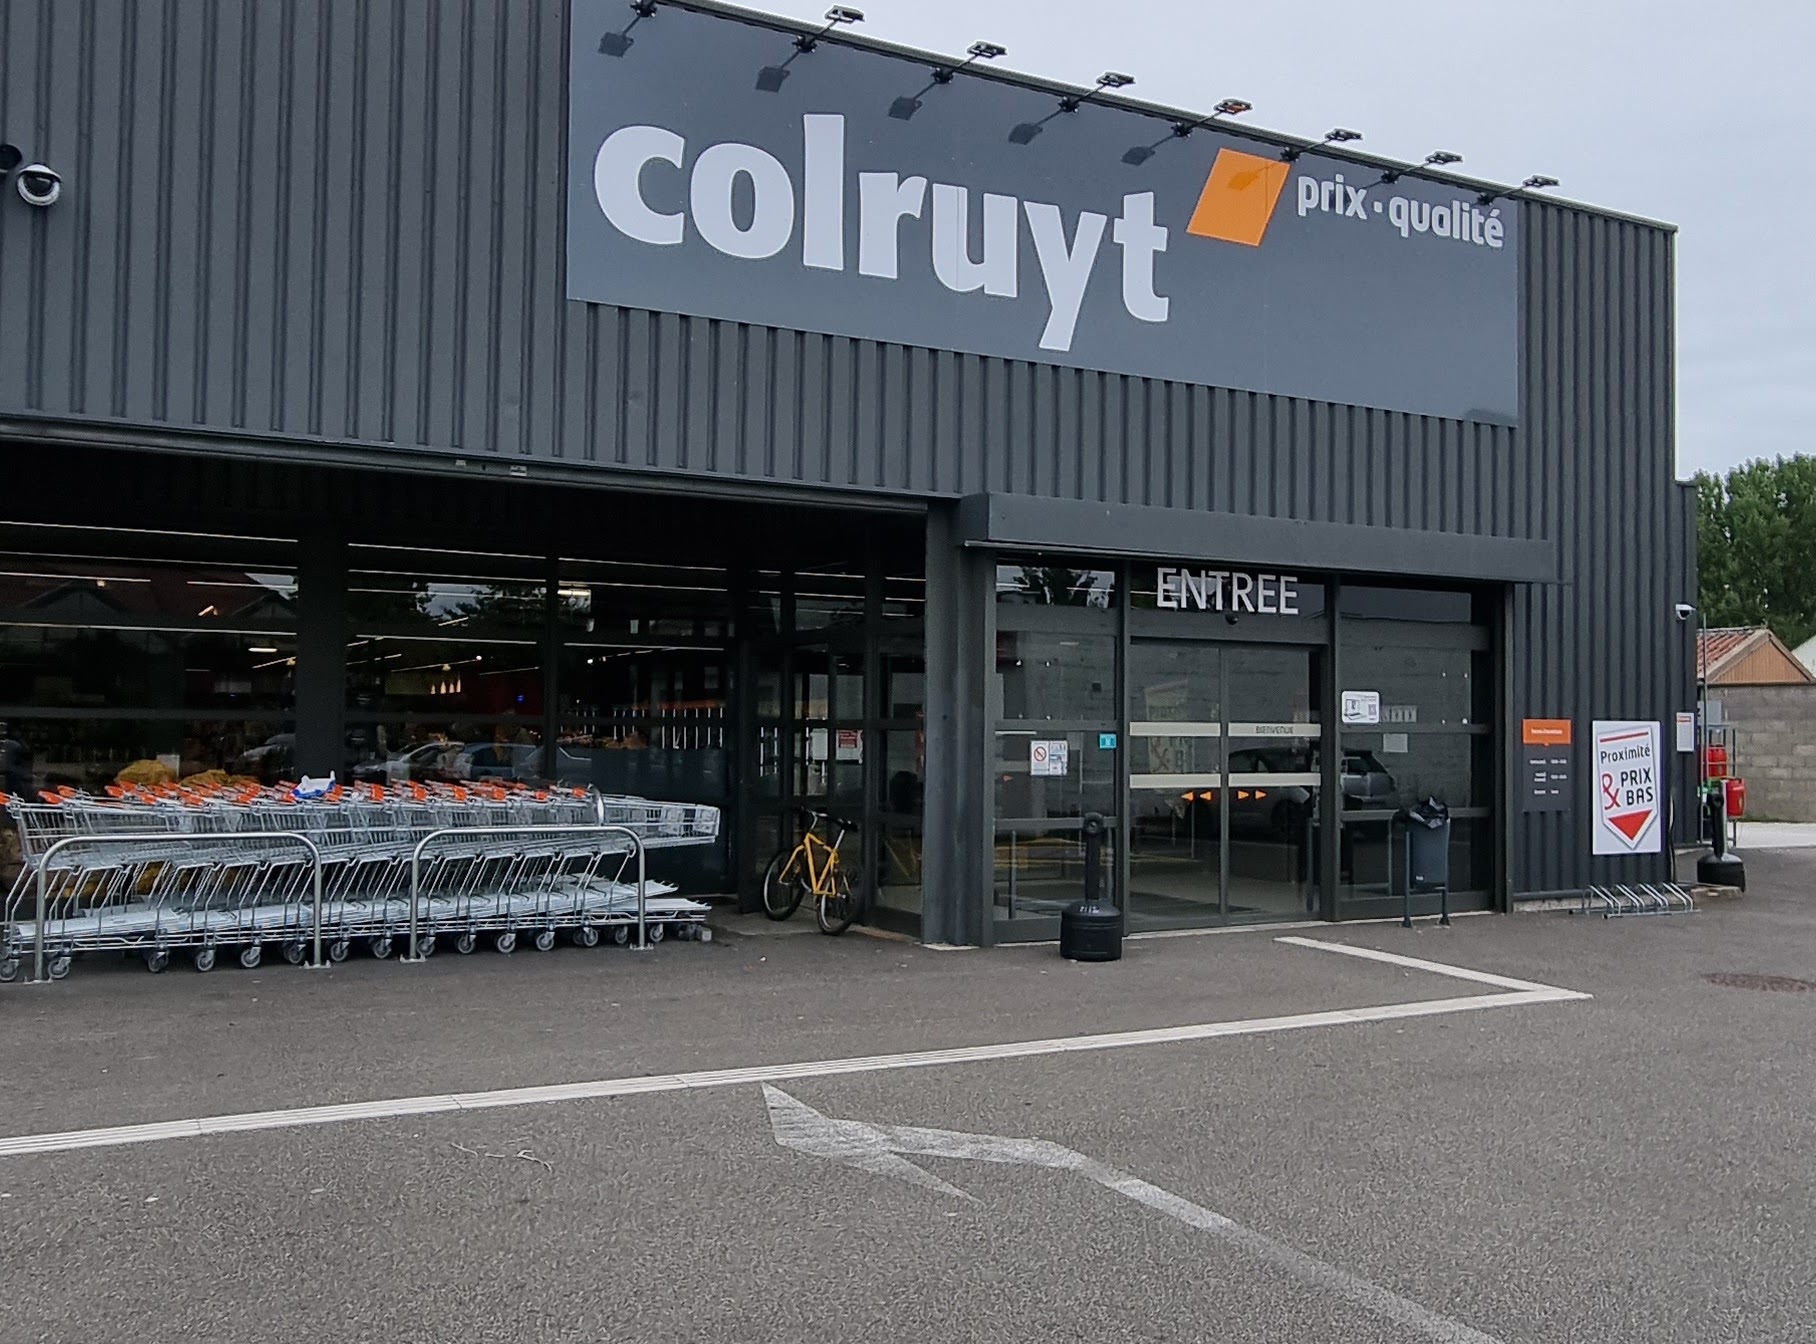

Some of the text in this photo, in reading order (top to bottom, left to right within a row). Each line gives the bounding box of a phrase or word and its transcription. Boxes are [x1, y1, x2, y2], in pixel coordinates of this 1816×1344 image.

[1297, 173, 1368, 220] prix
[1388, 196, 1504, 248] qualité
[593, 113, 1169, 352] colruyt
[1156, 567, 1299, 615] ENTREE
[1600, 743, 1651, 764] Proximité
[1620, 767, 1652, 787] PRIX
[1626, 786, 1653, 806] BAS
